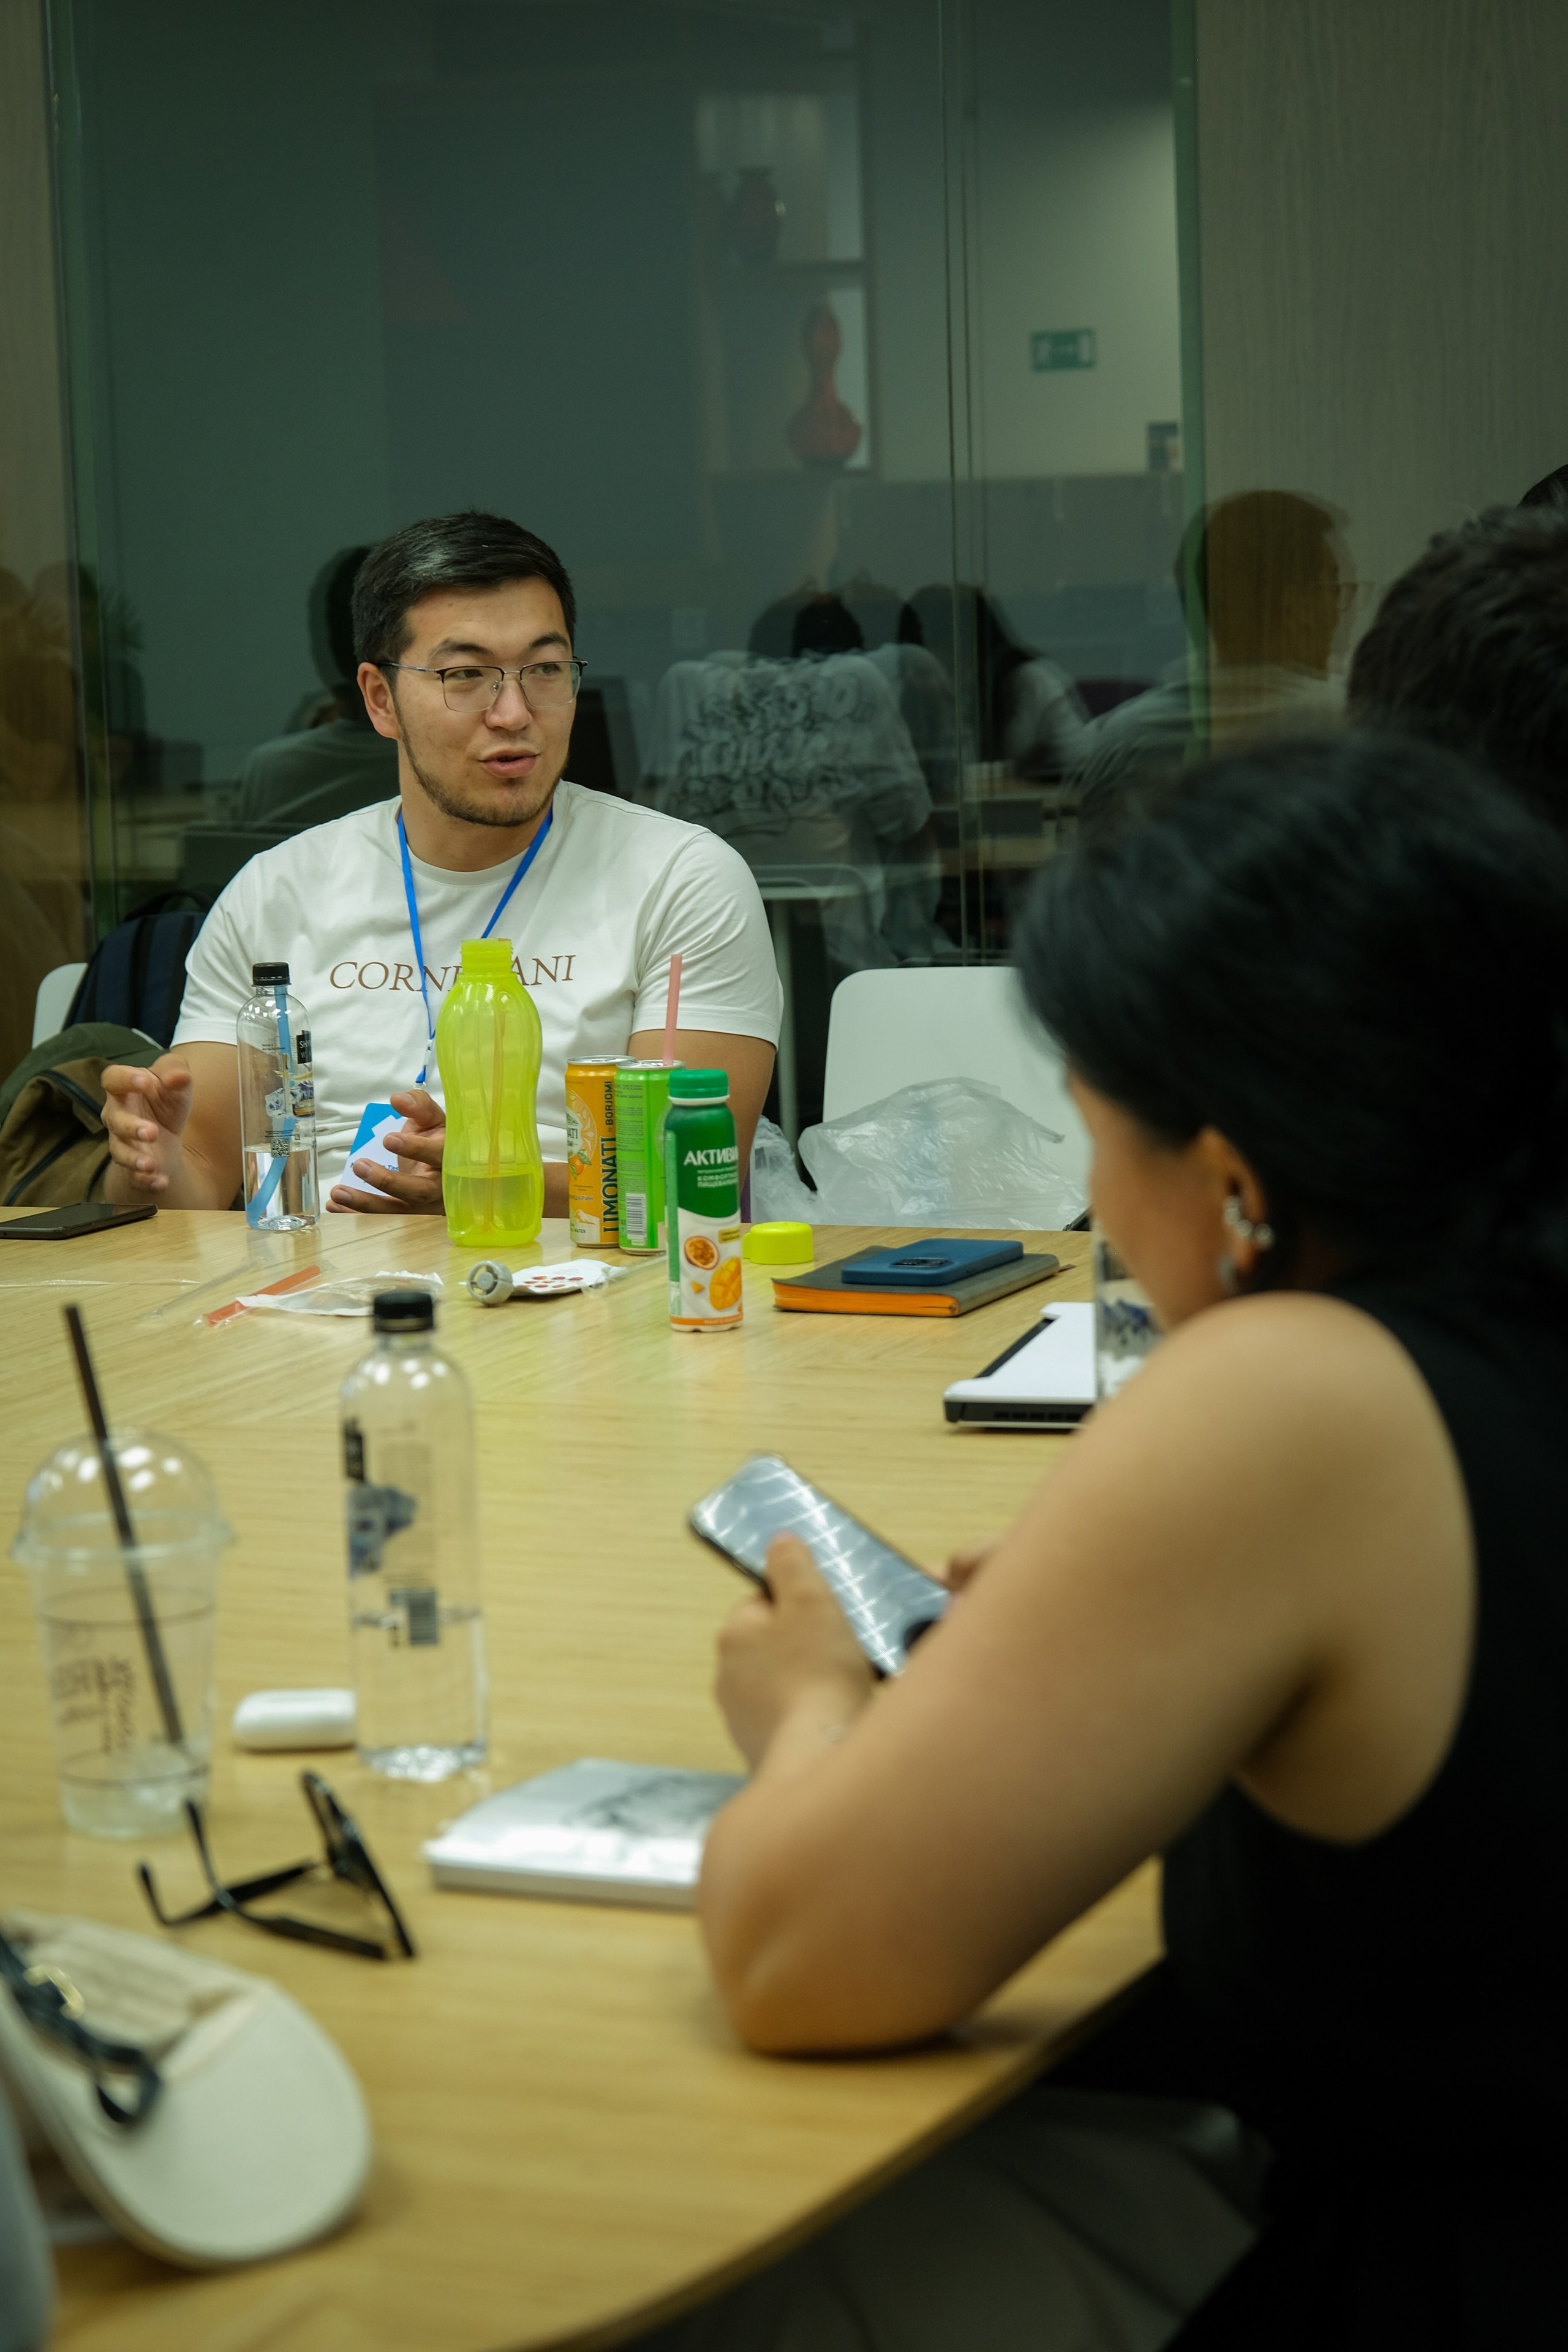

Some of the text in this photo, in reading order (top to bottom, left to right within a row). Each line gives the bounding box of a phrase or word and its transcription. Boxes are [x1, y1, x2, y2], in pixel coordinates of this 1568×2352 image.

[330, 954, 576, 992] CORNANI
[604, 1081, 614, 1126] BORJOMI
[683, 1145, 739, 1166] АКТИВИ
